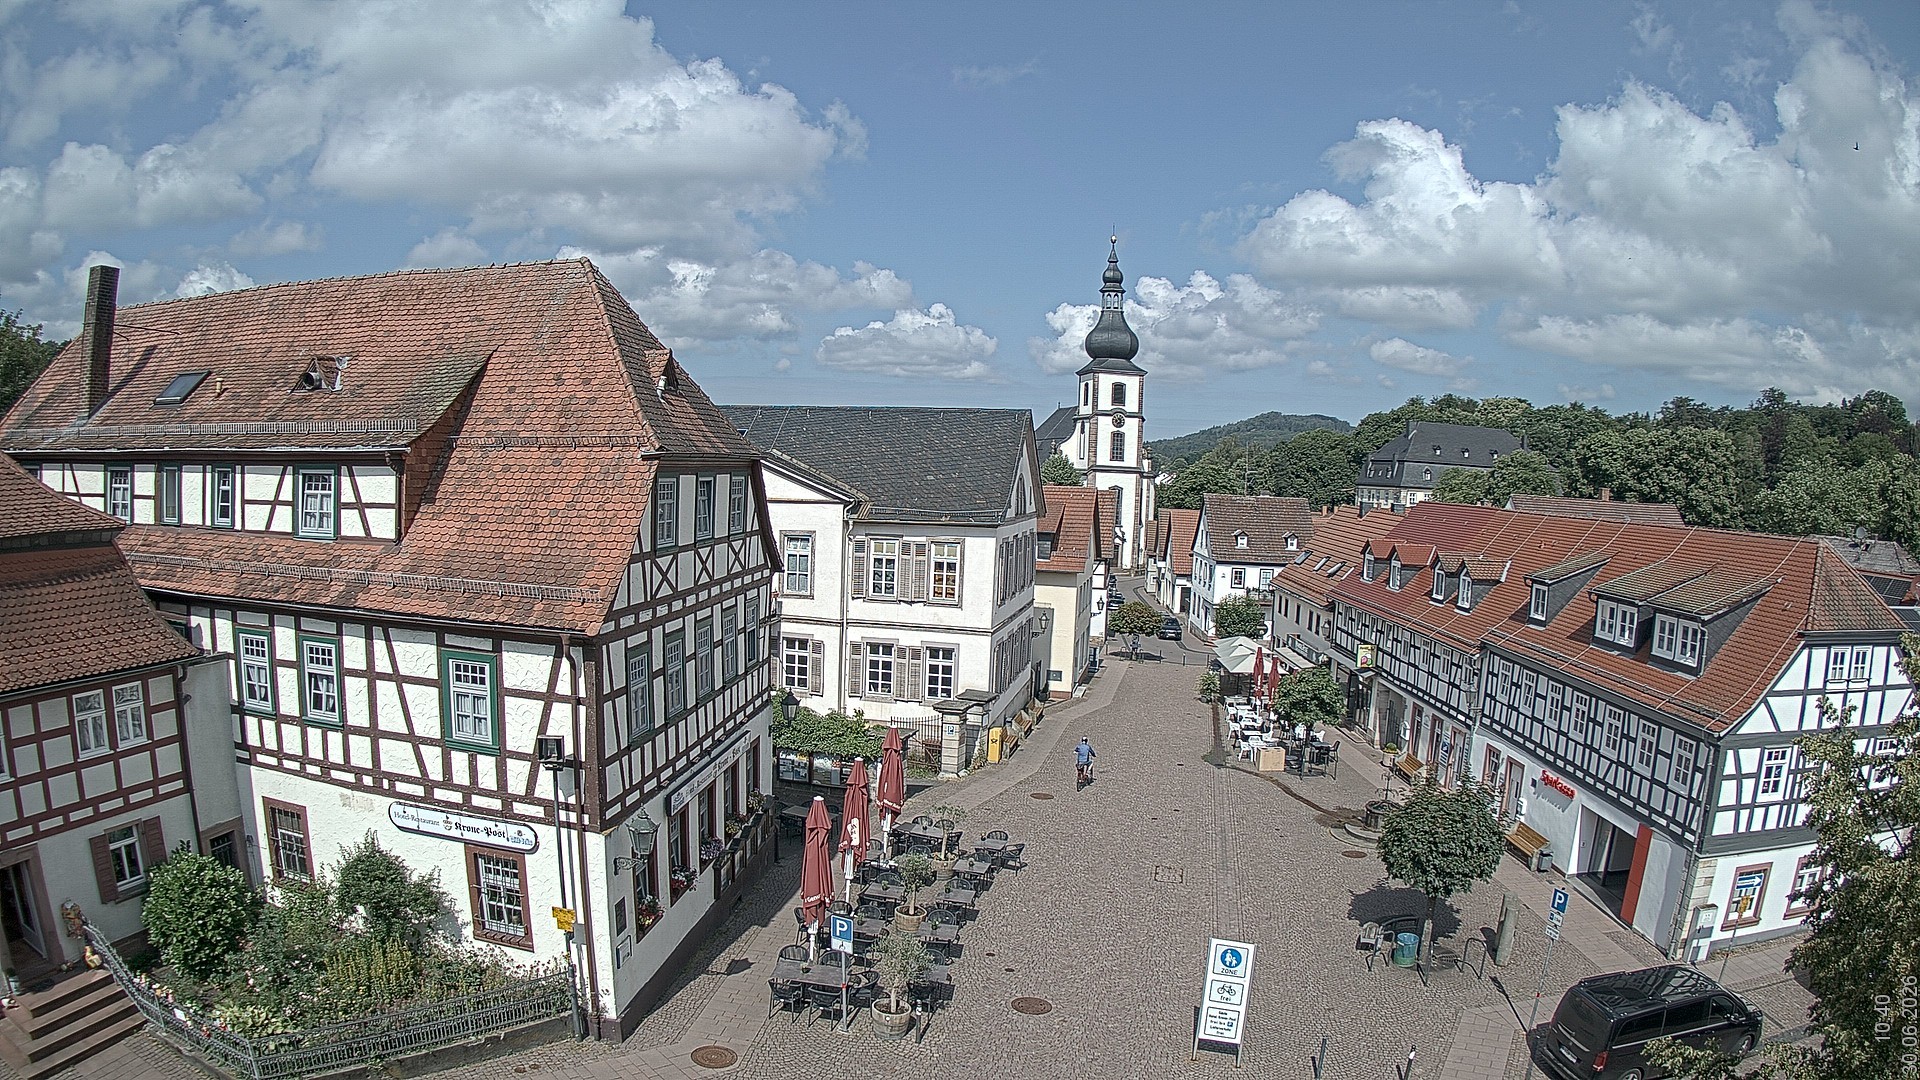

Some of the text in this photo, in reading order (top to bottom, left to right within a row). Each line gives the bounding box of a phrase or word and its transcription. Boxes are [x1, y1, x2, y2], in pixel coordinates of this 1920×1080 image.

[1540, 770, 1576, 800] Sparkasse
[454, 821, 506, 839] Krone-Post
[1554, 892, 1565, 908] P
[836, 919, 848, 936] P
[1221, 967, 1238, 975] ZONE
